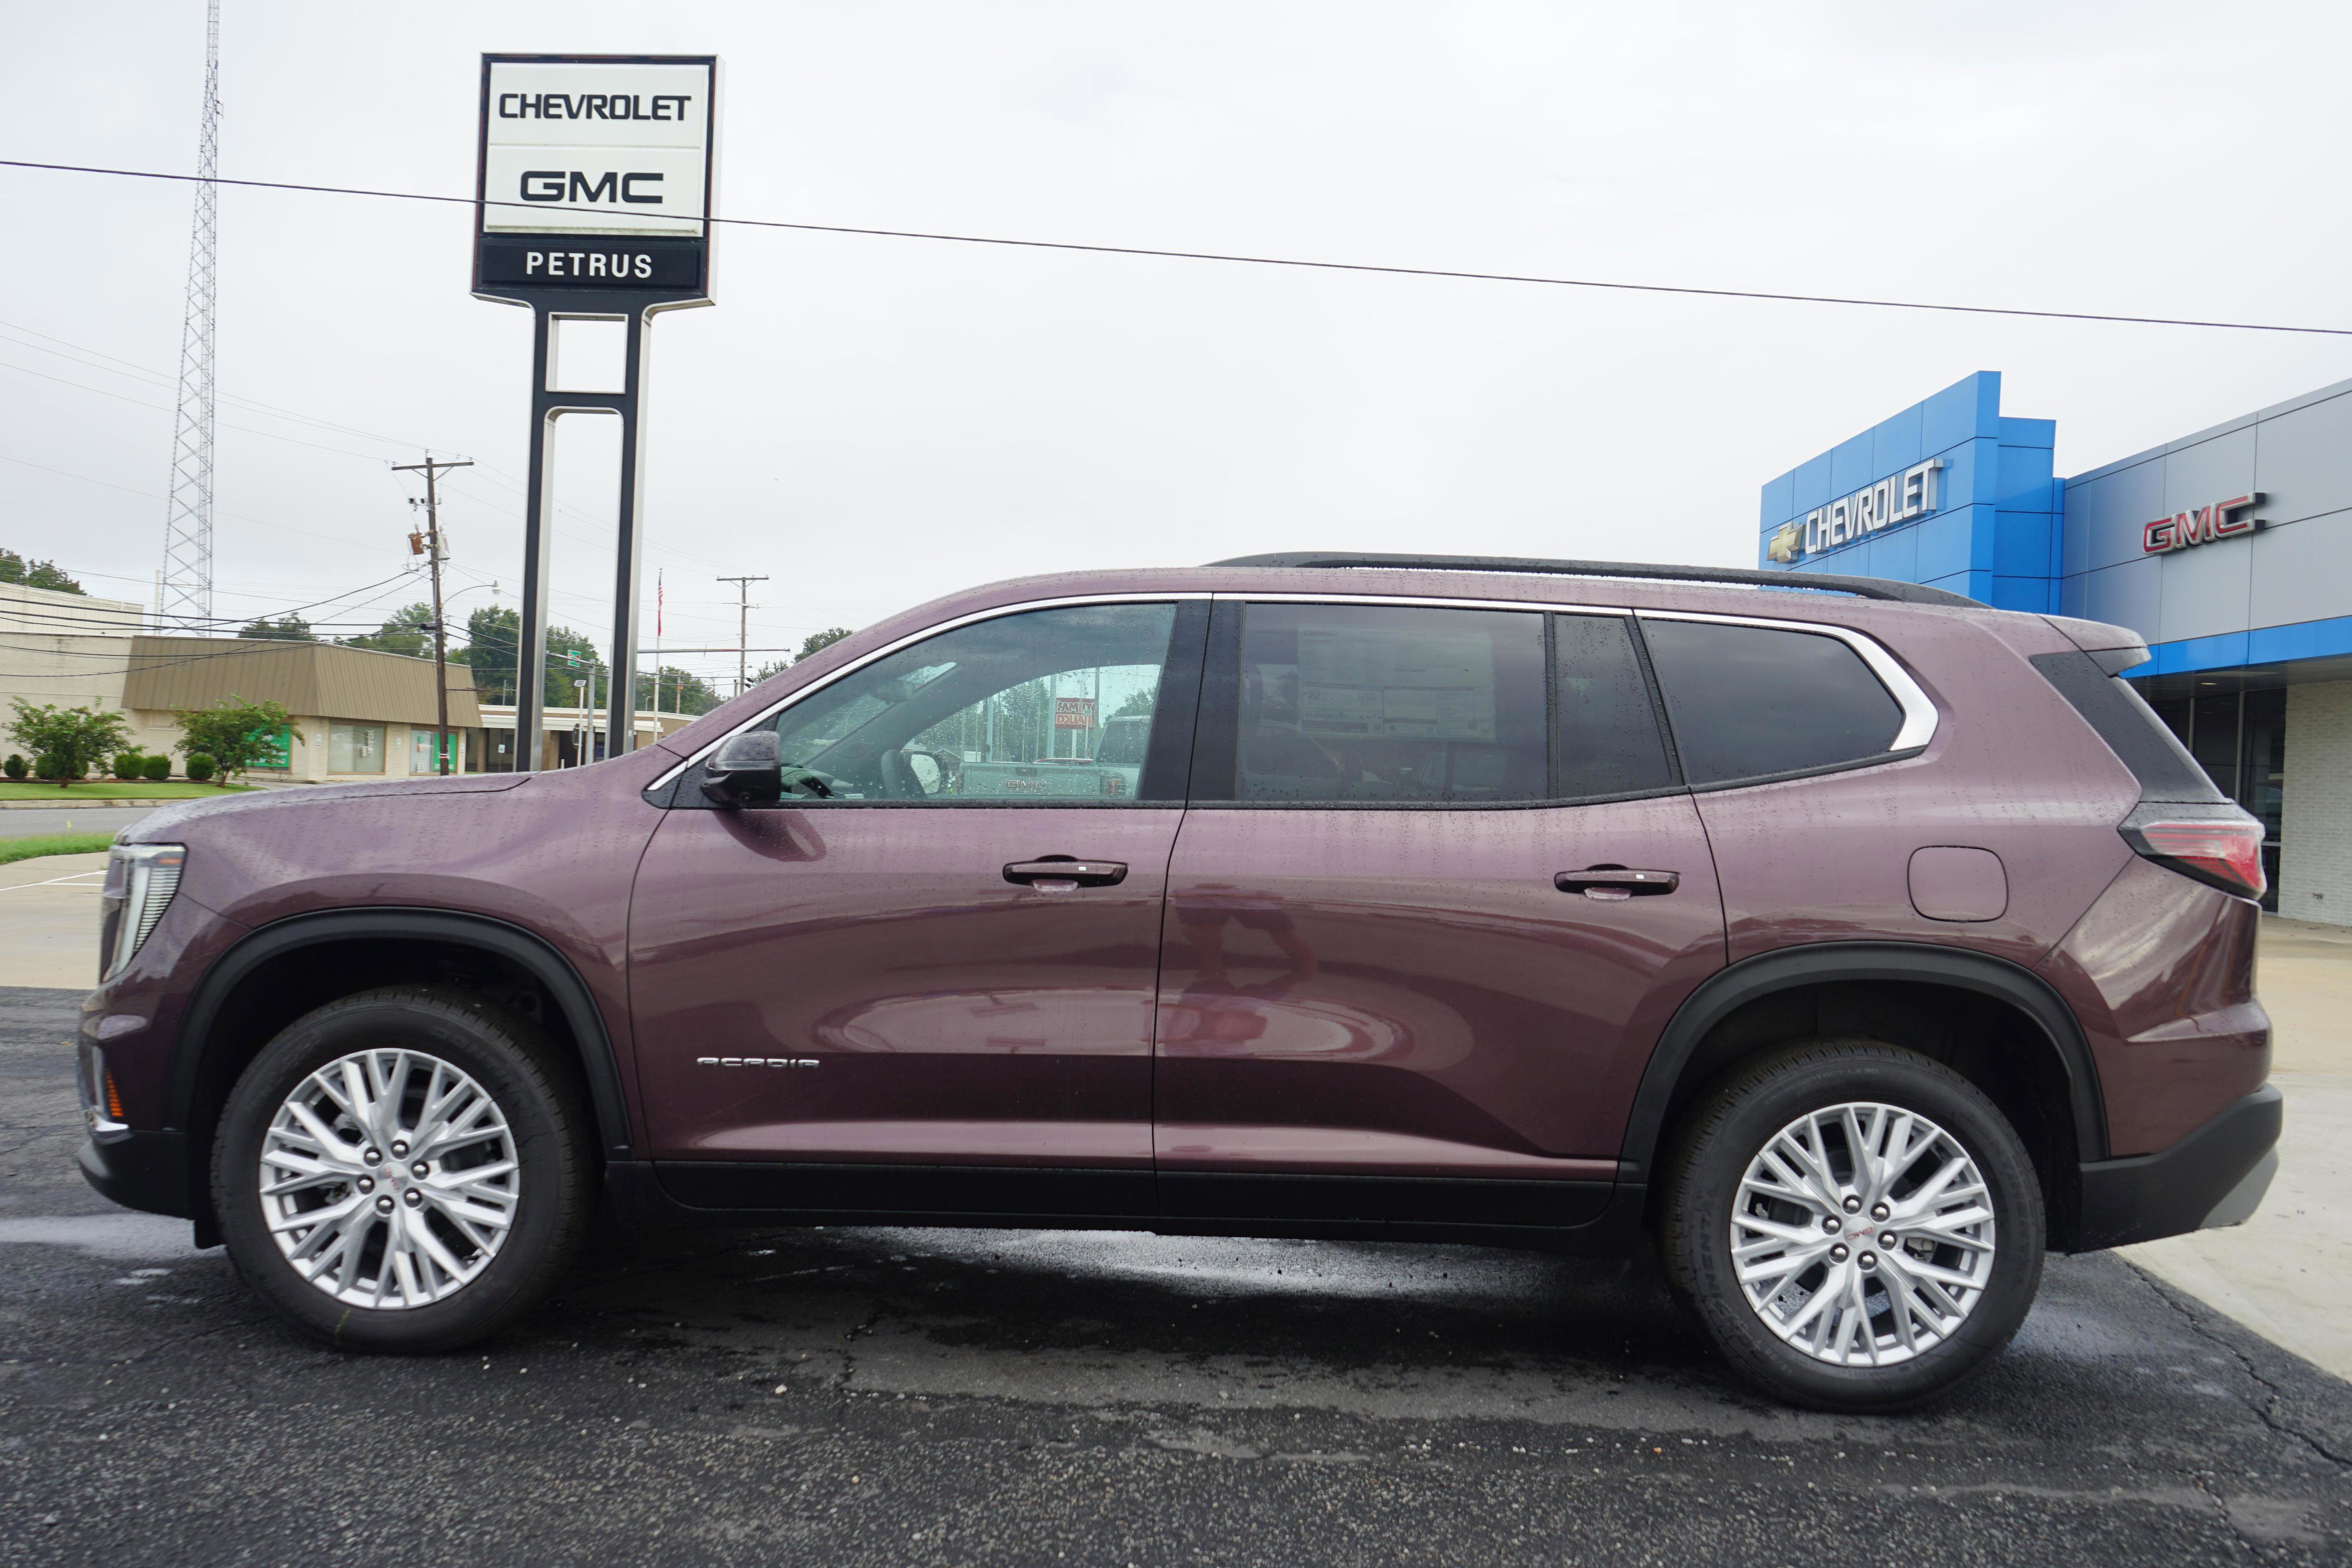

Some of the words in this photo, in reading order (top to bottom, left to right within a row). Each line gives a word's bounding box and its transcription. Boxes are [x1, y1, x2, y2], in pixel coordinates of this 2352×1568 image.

[499, 94, 692, 121] CHEVROLET
[520, 171, 664, 204] GMC
[526, 252, 652, 278] PETRUS
[1805, 458, 1942, 554] CHEVROLET
[2143, 492, 2261, 555] GMC
[1006, 780, 1047, 790] GMC
[697, 1057, 820, 1068] ACADIA
[1846, 1226, 1875, 1241] GMC
